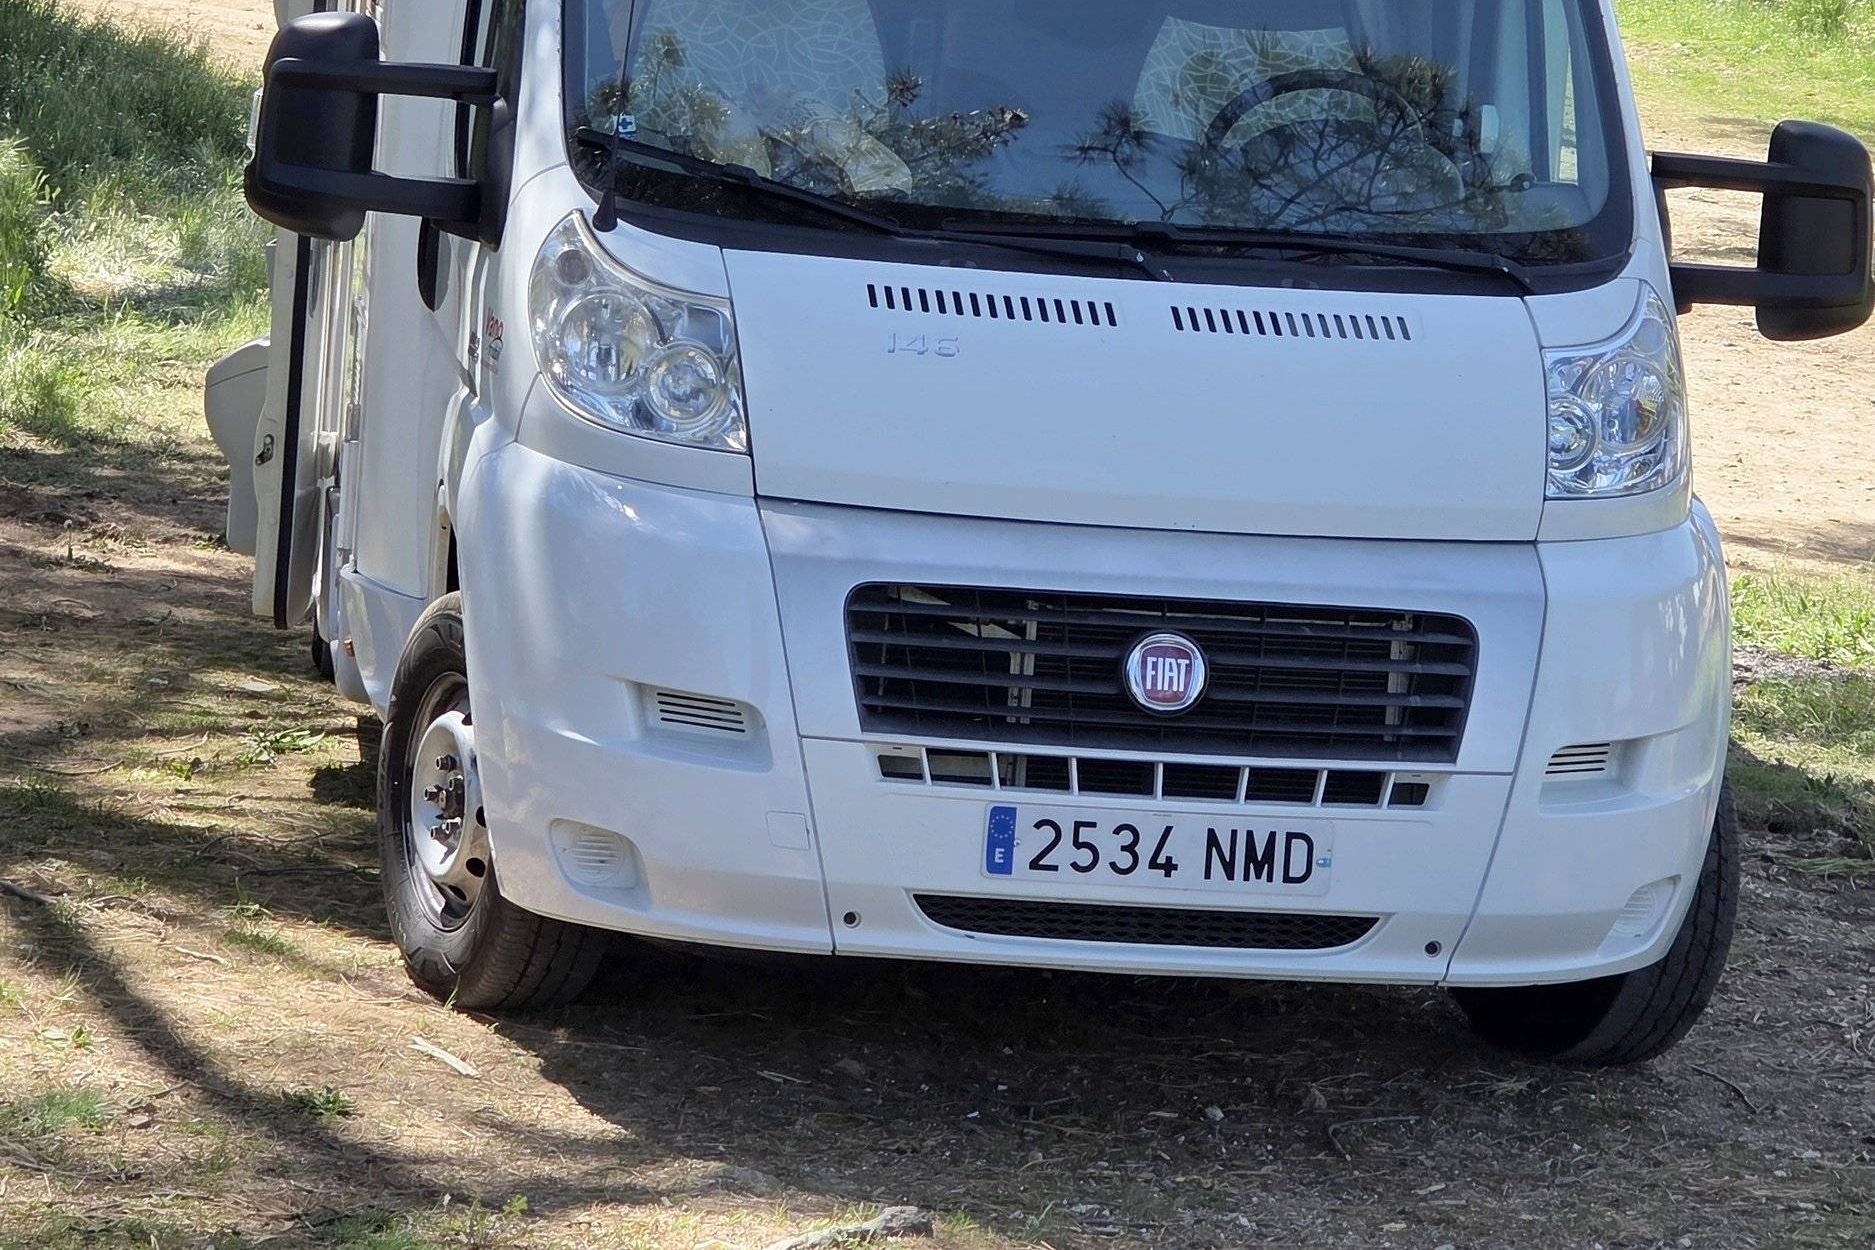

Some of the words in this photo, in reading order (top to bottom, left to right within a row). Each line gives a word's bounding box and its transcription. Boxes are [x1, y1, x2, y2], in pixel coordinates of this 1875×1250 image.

[1145, 656, 1190, 692] FIAT
[994, 847, 1005, 863] E
[1028, 818, 1179, 878] 2534
[1203, 827, 1315, 884] NMD
